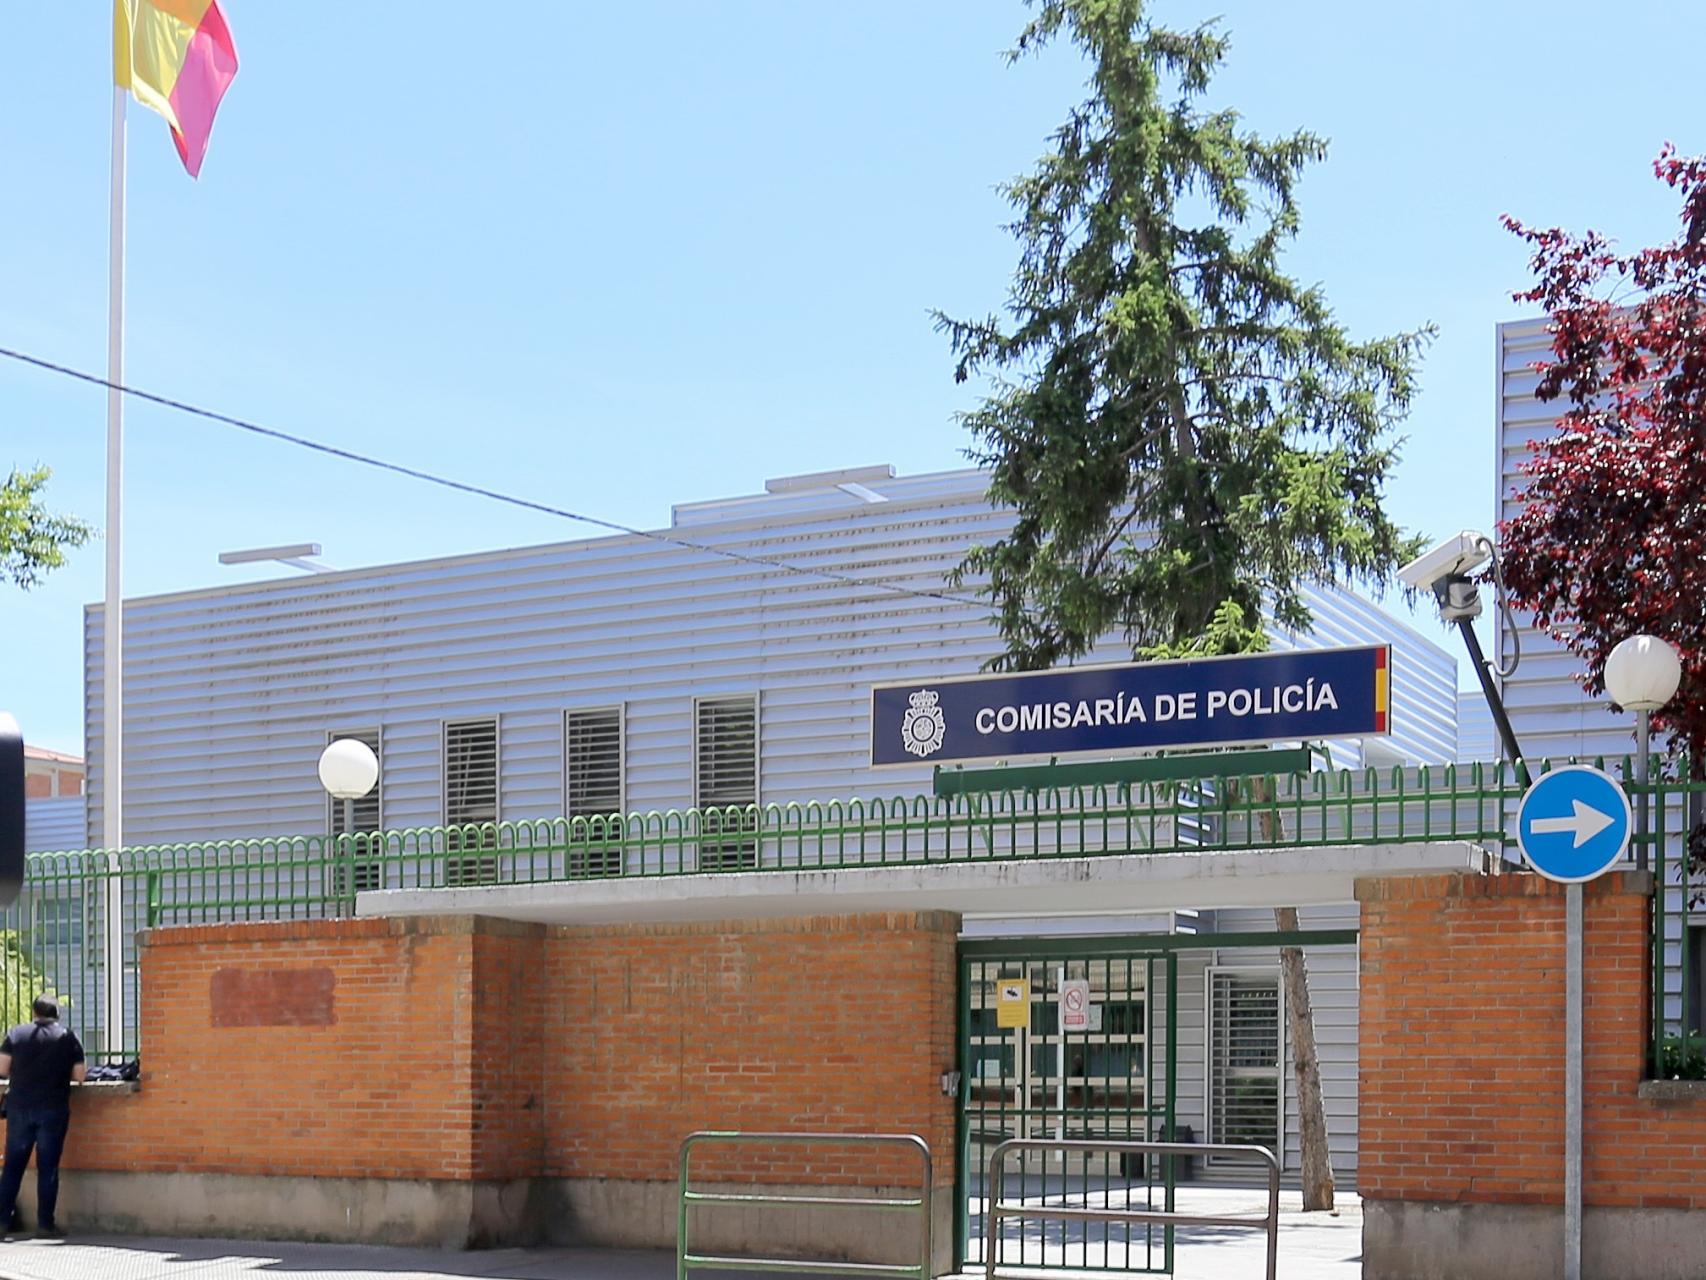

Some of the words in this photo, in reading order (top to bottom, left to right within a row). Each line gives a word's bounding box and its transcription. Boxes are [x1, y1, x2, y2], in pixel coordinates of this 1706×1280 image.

[975, 691, 1147, 735] COMISARÍA
[1155, 692, 1197, 722] DE
[1207, 677, 1339, 718] POLICÍA
